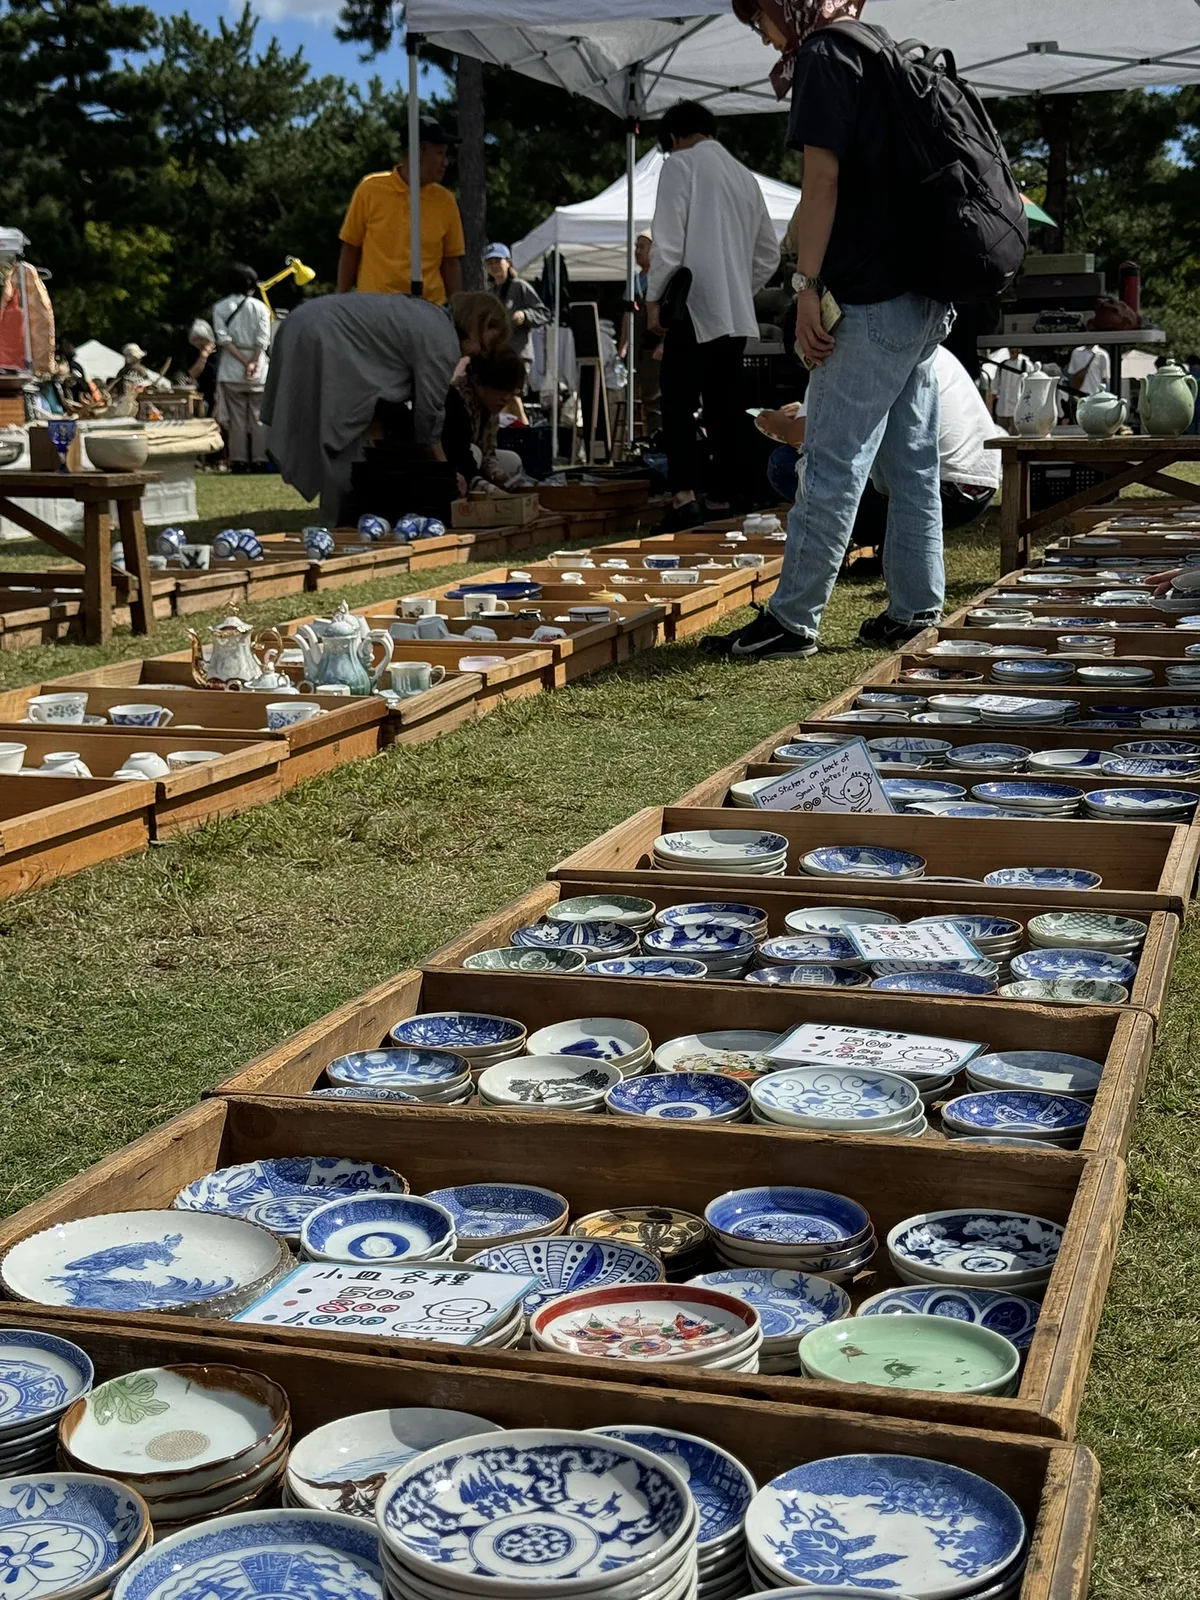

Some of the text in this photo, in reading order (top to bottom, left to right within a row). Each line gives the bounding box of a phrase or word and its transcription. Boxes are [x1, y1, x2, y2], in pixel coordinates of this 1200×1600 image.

[760, 751, 850, 806] Price Stickers on back of
[795, 783, 816, 801] Small
[839, 1036, 893, 1049] 500
[312, 1267, 475, 1286] 小皿各種
[336, 1285, 415, 1300] 500
[316, 1299, 401, 1314] 800
[282, 1310, 387, 1326] 1.000
